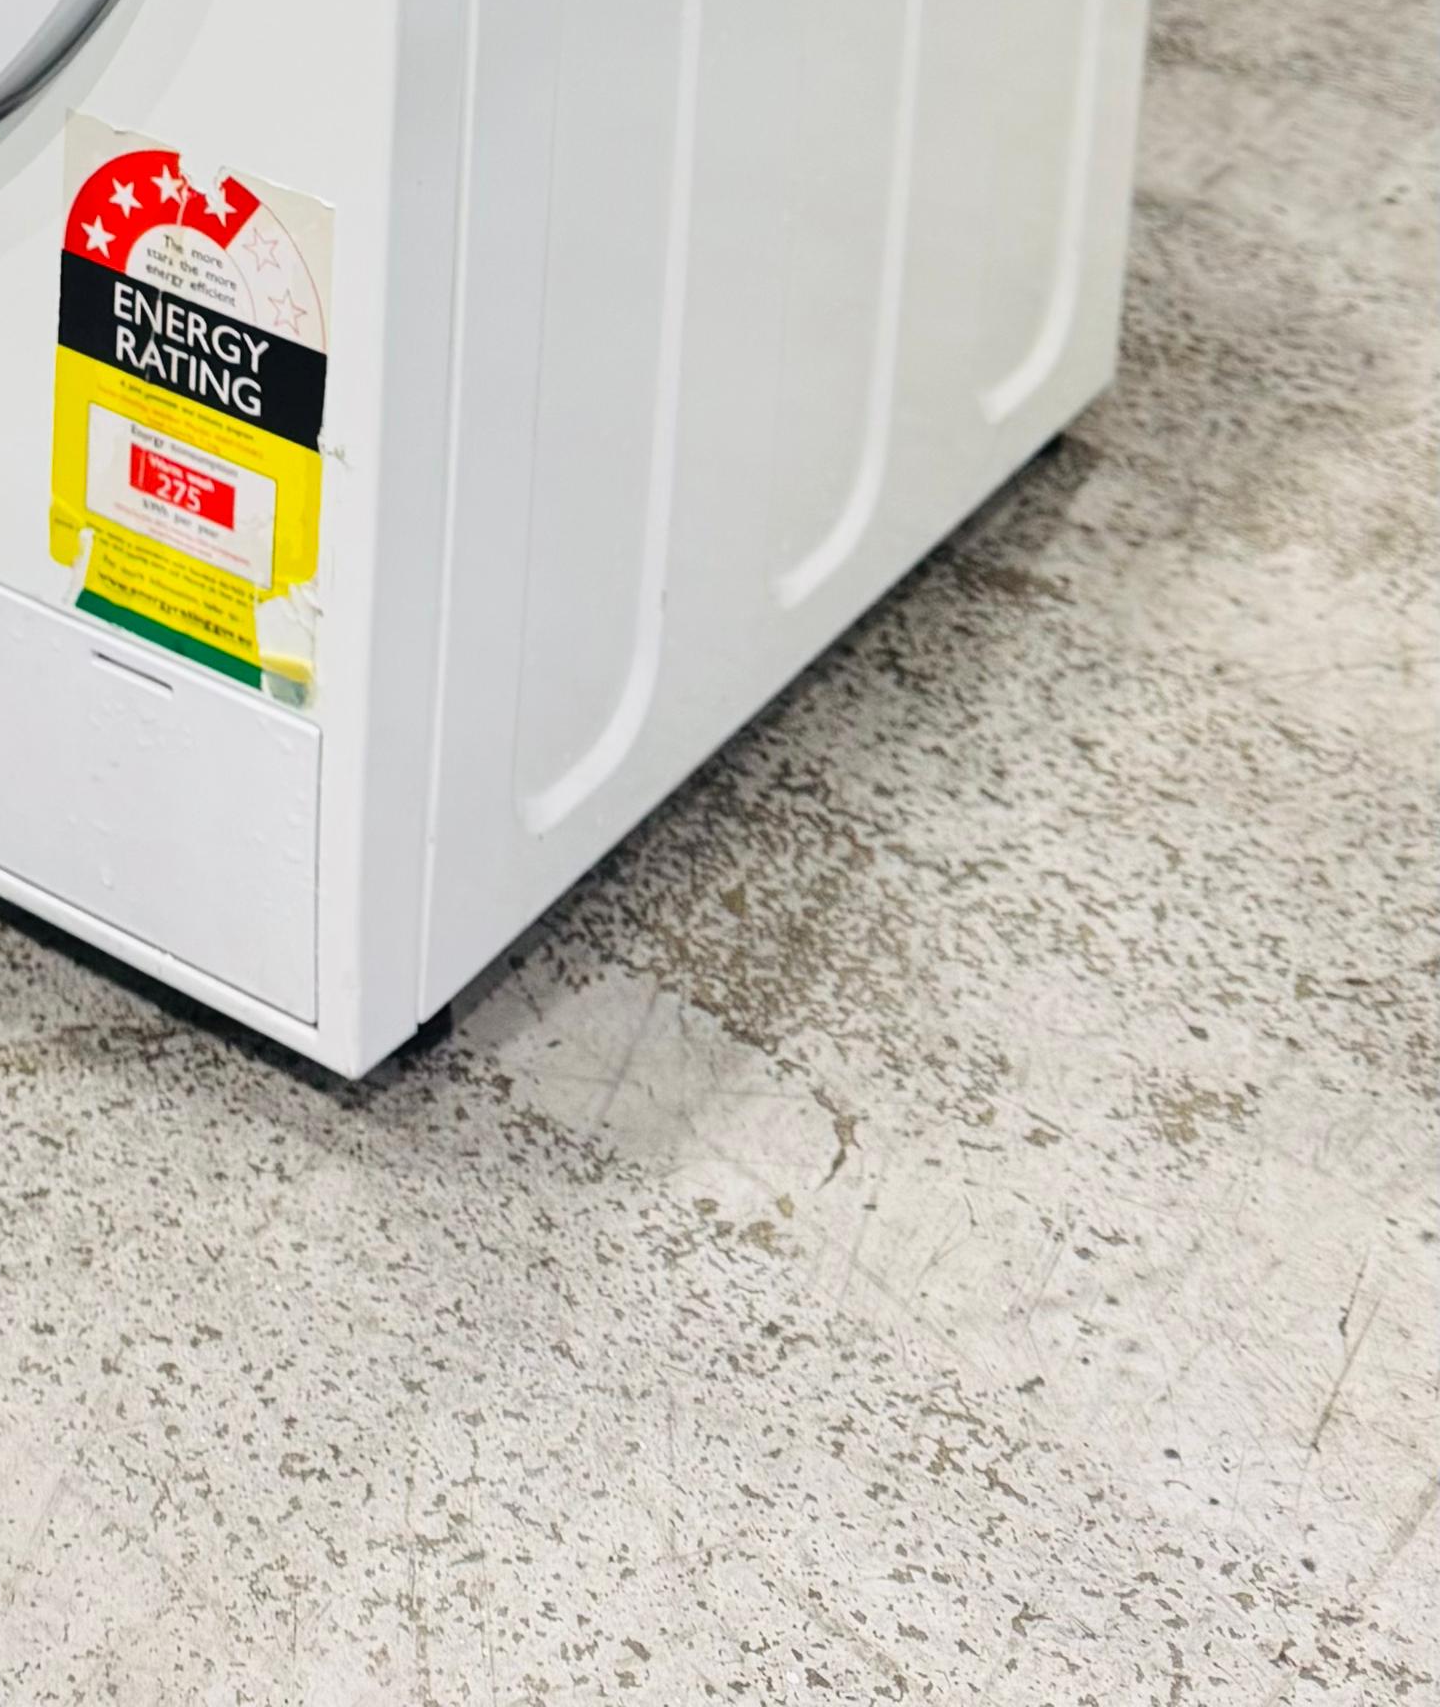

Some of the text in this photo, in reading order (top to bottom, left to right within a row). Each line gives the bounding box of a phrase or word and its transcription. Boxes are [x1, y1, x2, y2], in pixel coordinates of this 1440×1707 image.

[147, 248, 237, 292] stars the more
[164, 234, 223, 269] The more
[145, 263, 236, 308] energy efficient
[114, 280, 270, 375] ENERGY
[115, 324, 263, 418] RATING
[155, 472, 203, 514] 275
